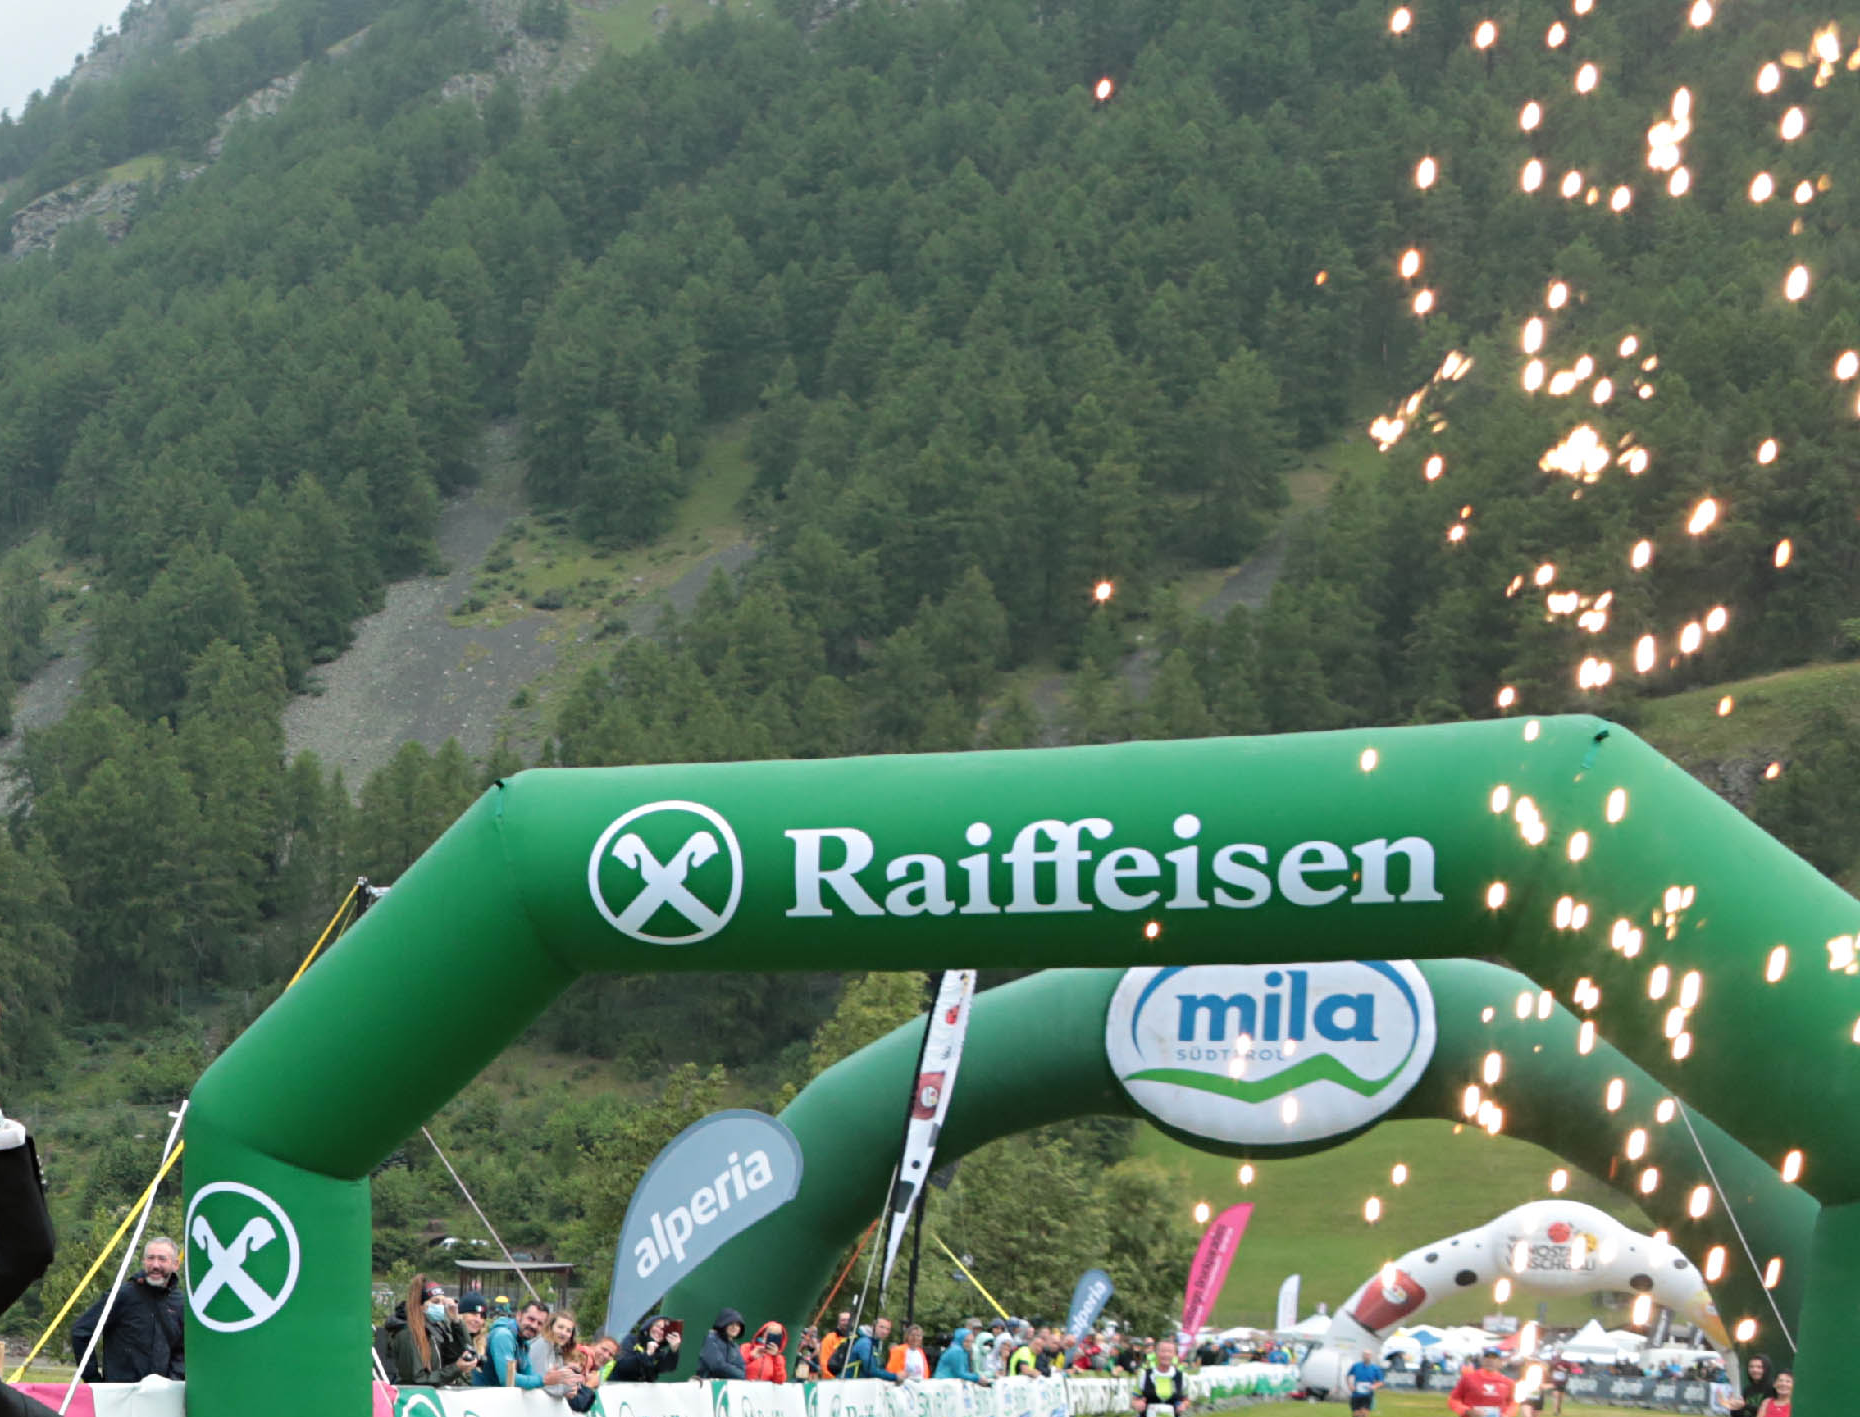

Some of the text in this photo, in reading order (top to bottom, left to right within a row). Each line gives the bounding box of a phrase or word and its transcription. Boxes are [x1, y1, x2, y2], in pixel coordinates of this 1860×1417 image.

[784, 814, 1444, 918] Raiffeisen
[1176, 969, 1379, 1042] mila
[1176, 1047, 1285, 1061] SÜDTROL
[634, 1149, 773, 1279] alperia
